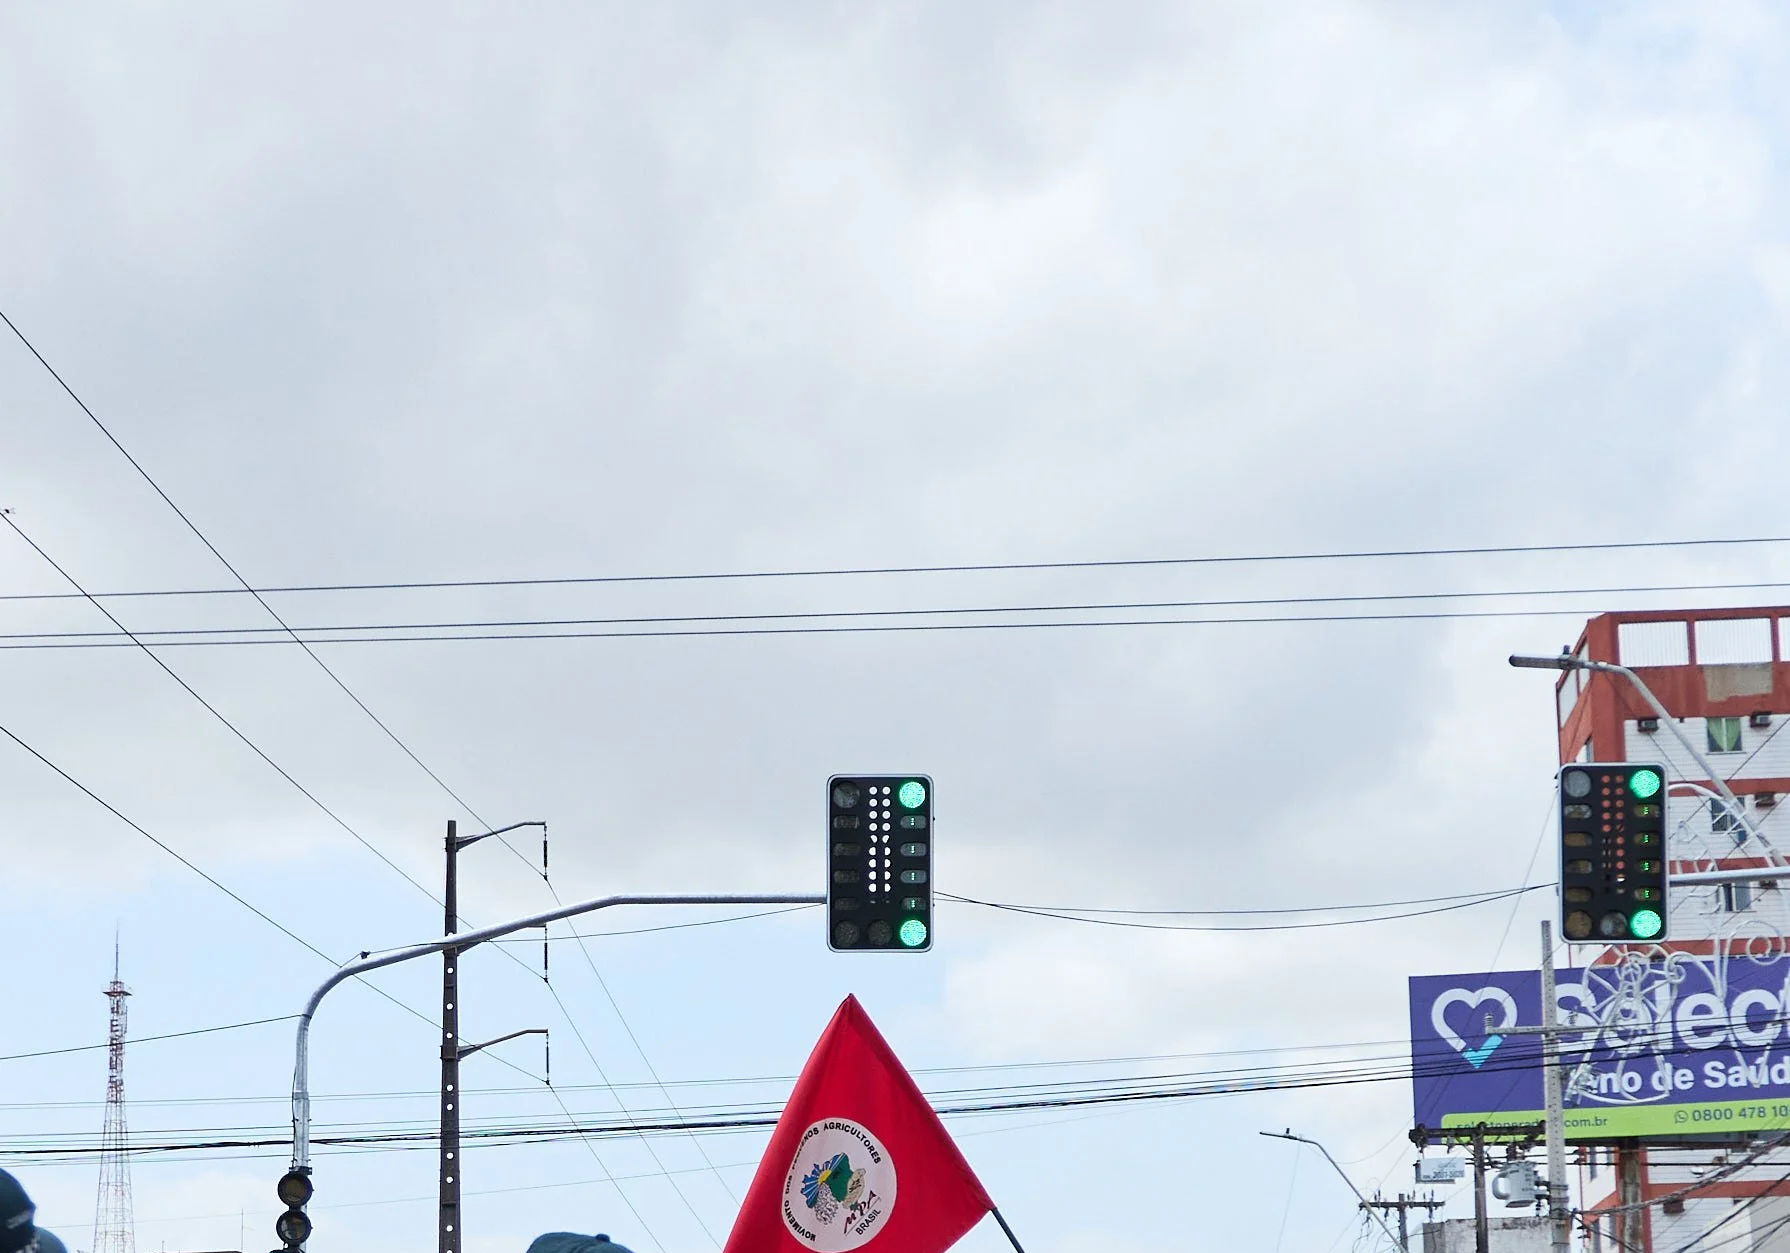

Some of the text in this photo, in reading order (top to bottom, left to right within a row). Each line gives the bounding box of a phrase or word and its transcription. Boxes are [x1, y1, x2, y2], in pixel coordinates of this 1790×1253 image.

[1651, 1062, 1695, 1091] de
[1692, 1107, 1733, 1122] 0800
[1738, 1106, 1767, 1119] 478
[784, 1200, 817, 1242] MOVIMENTO
[823, 1121, 882, 1165] AGRICULTORES
[855, 1209, 881, 1235] BRASIL
